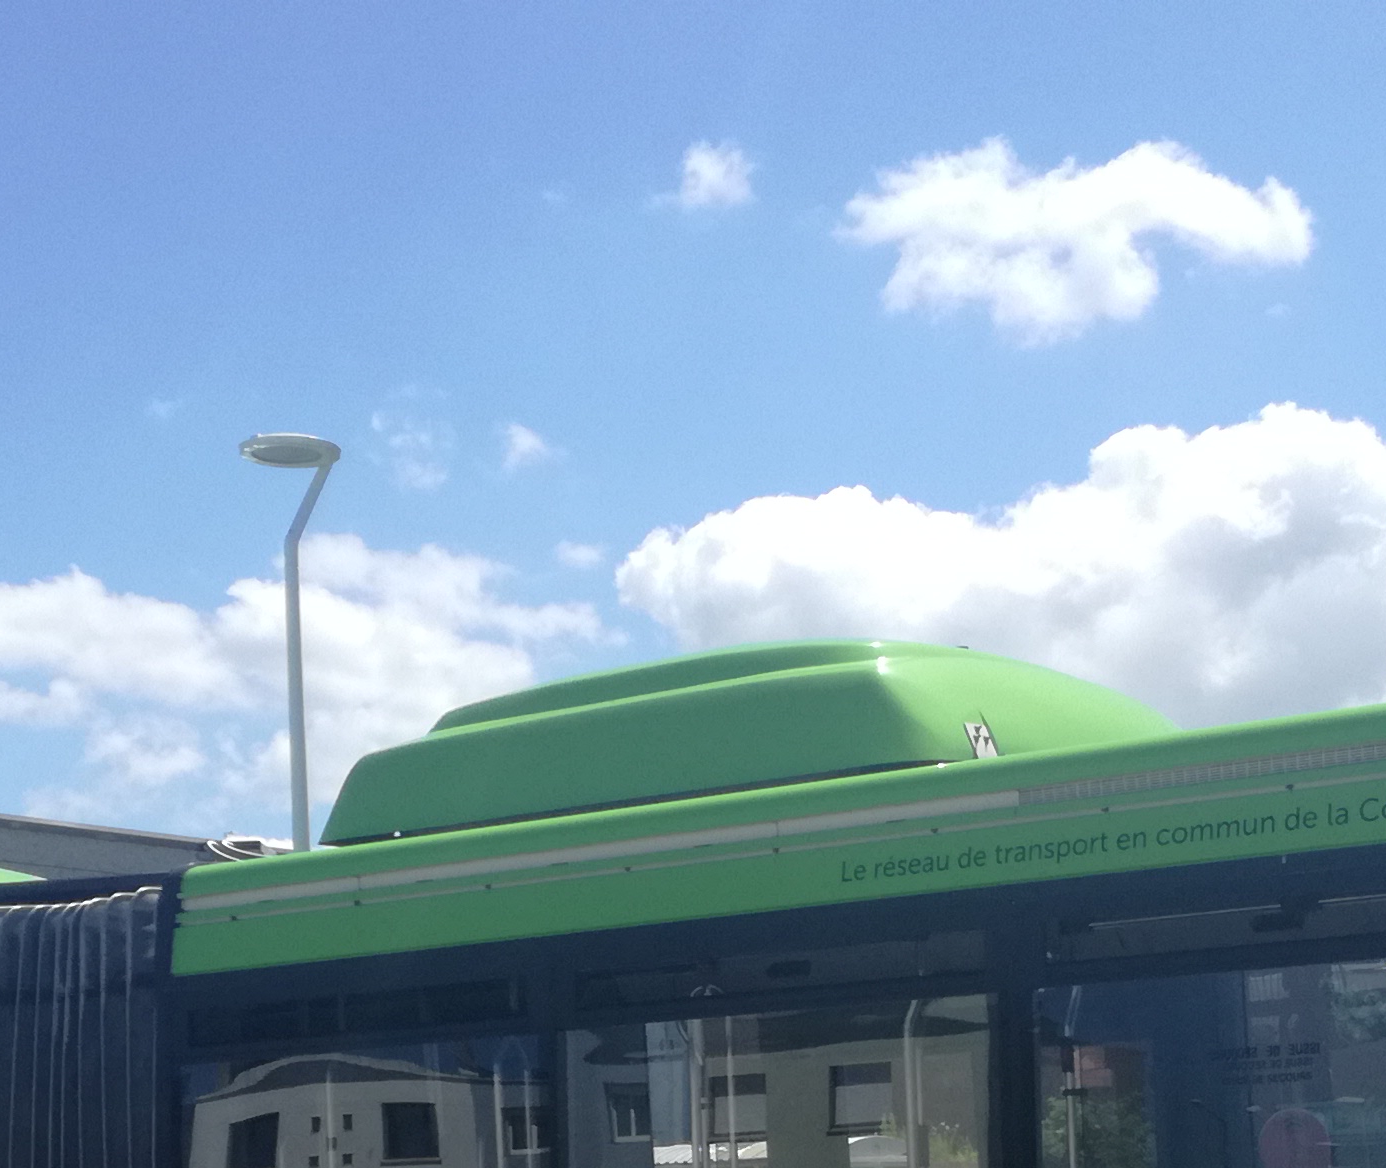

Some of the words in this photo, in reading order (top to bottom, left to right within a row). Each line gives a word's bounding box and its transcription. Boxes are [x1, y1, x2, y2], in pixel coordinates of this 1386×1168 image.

[841, 860, 867, 882] Le
[874, 854, 950, 879] réseau
[958, 847, 987, 869] de
[995, 833, 1109, 863] transport
[1116, 831, 1147, 850] en
[1156, 815, 1275, 845] commun
[1284, 807, 1318, 831] de
[1327, 803, 1349, 826] la
